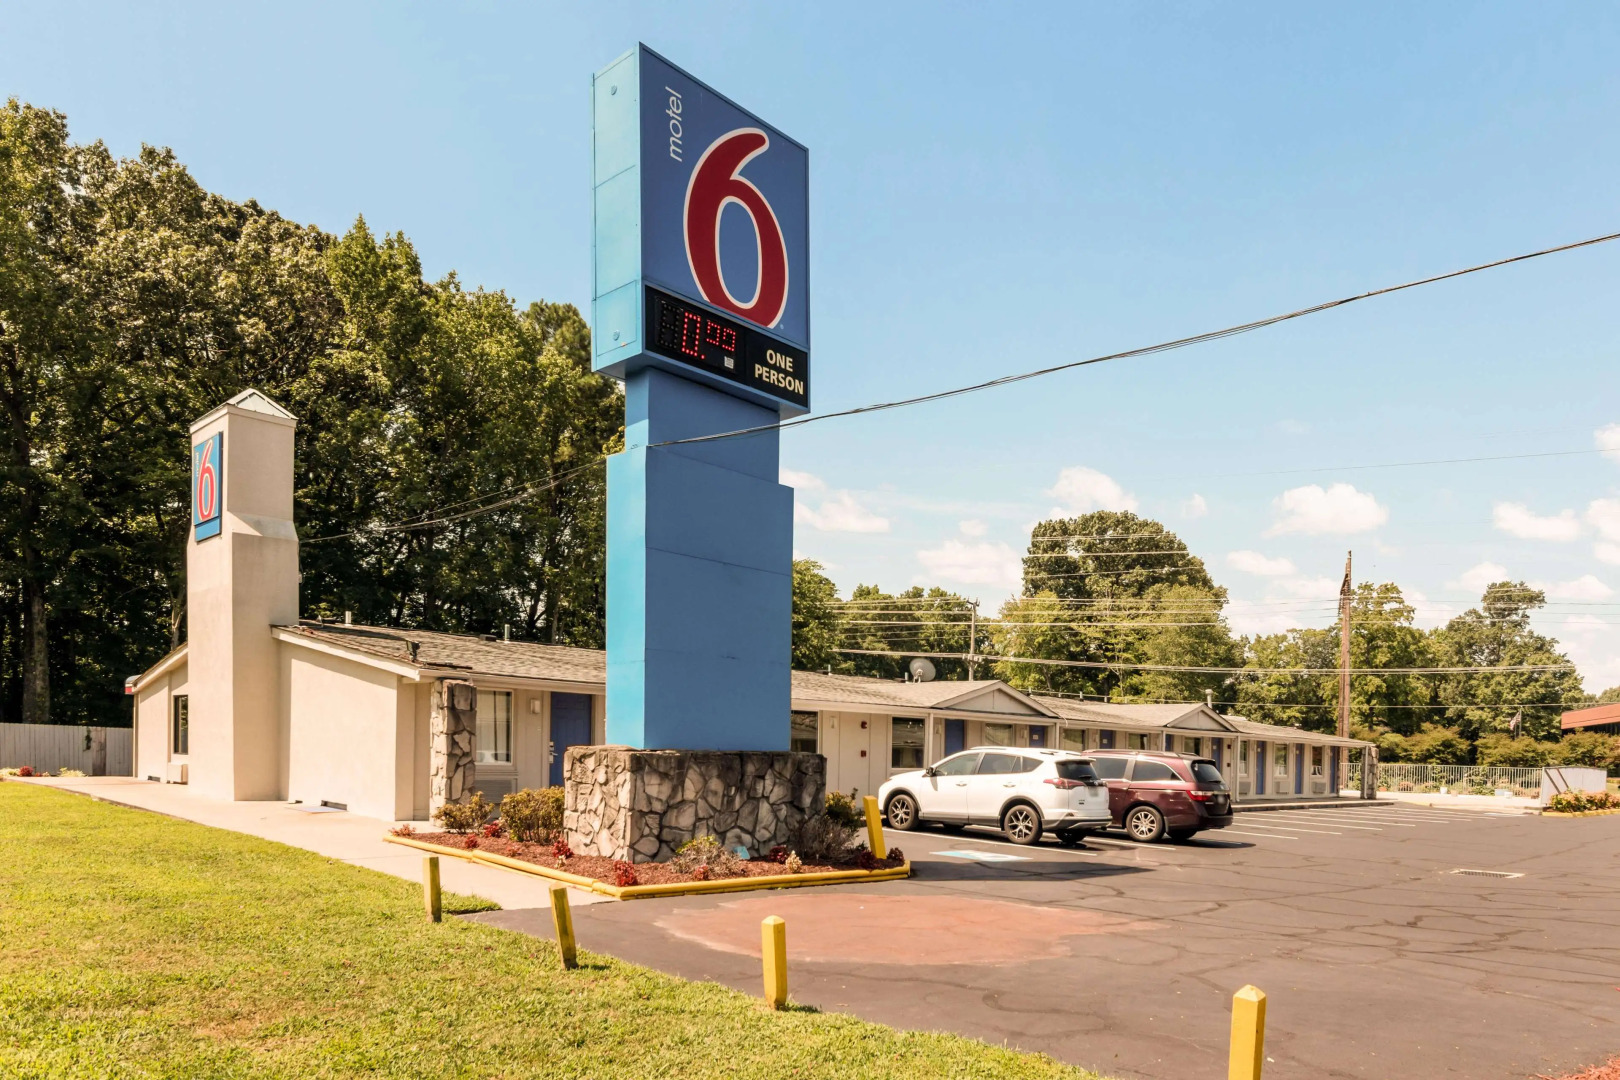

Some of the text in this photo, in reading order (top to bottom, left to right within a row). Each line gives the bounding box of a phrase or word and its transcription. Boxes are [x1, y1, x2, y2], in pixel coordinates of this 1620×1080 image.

[665, 86, 682, 162] motel
[683, 127, 789, 328] 6
[754, 363, 804, 395] PERSON
[766, 349, 794, 372] ONE
[197, 439, 216, 520] 6
